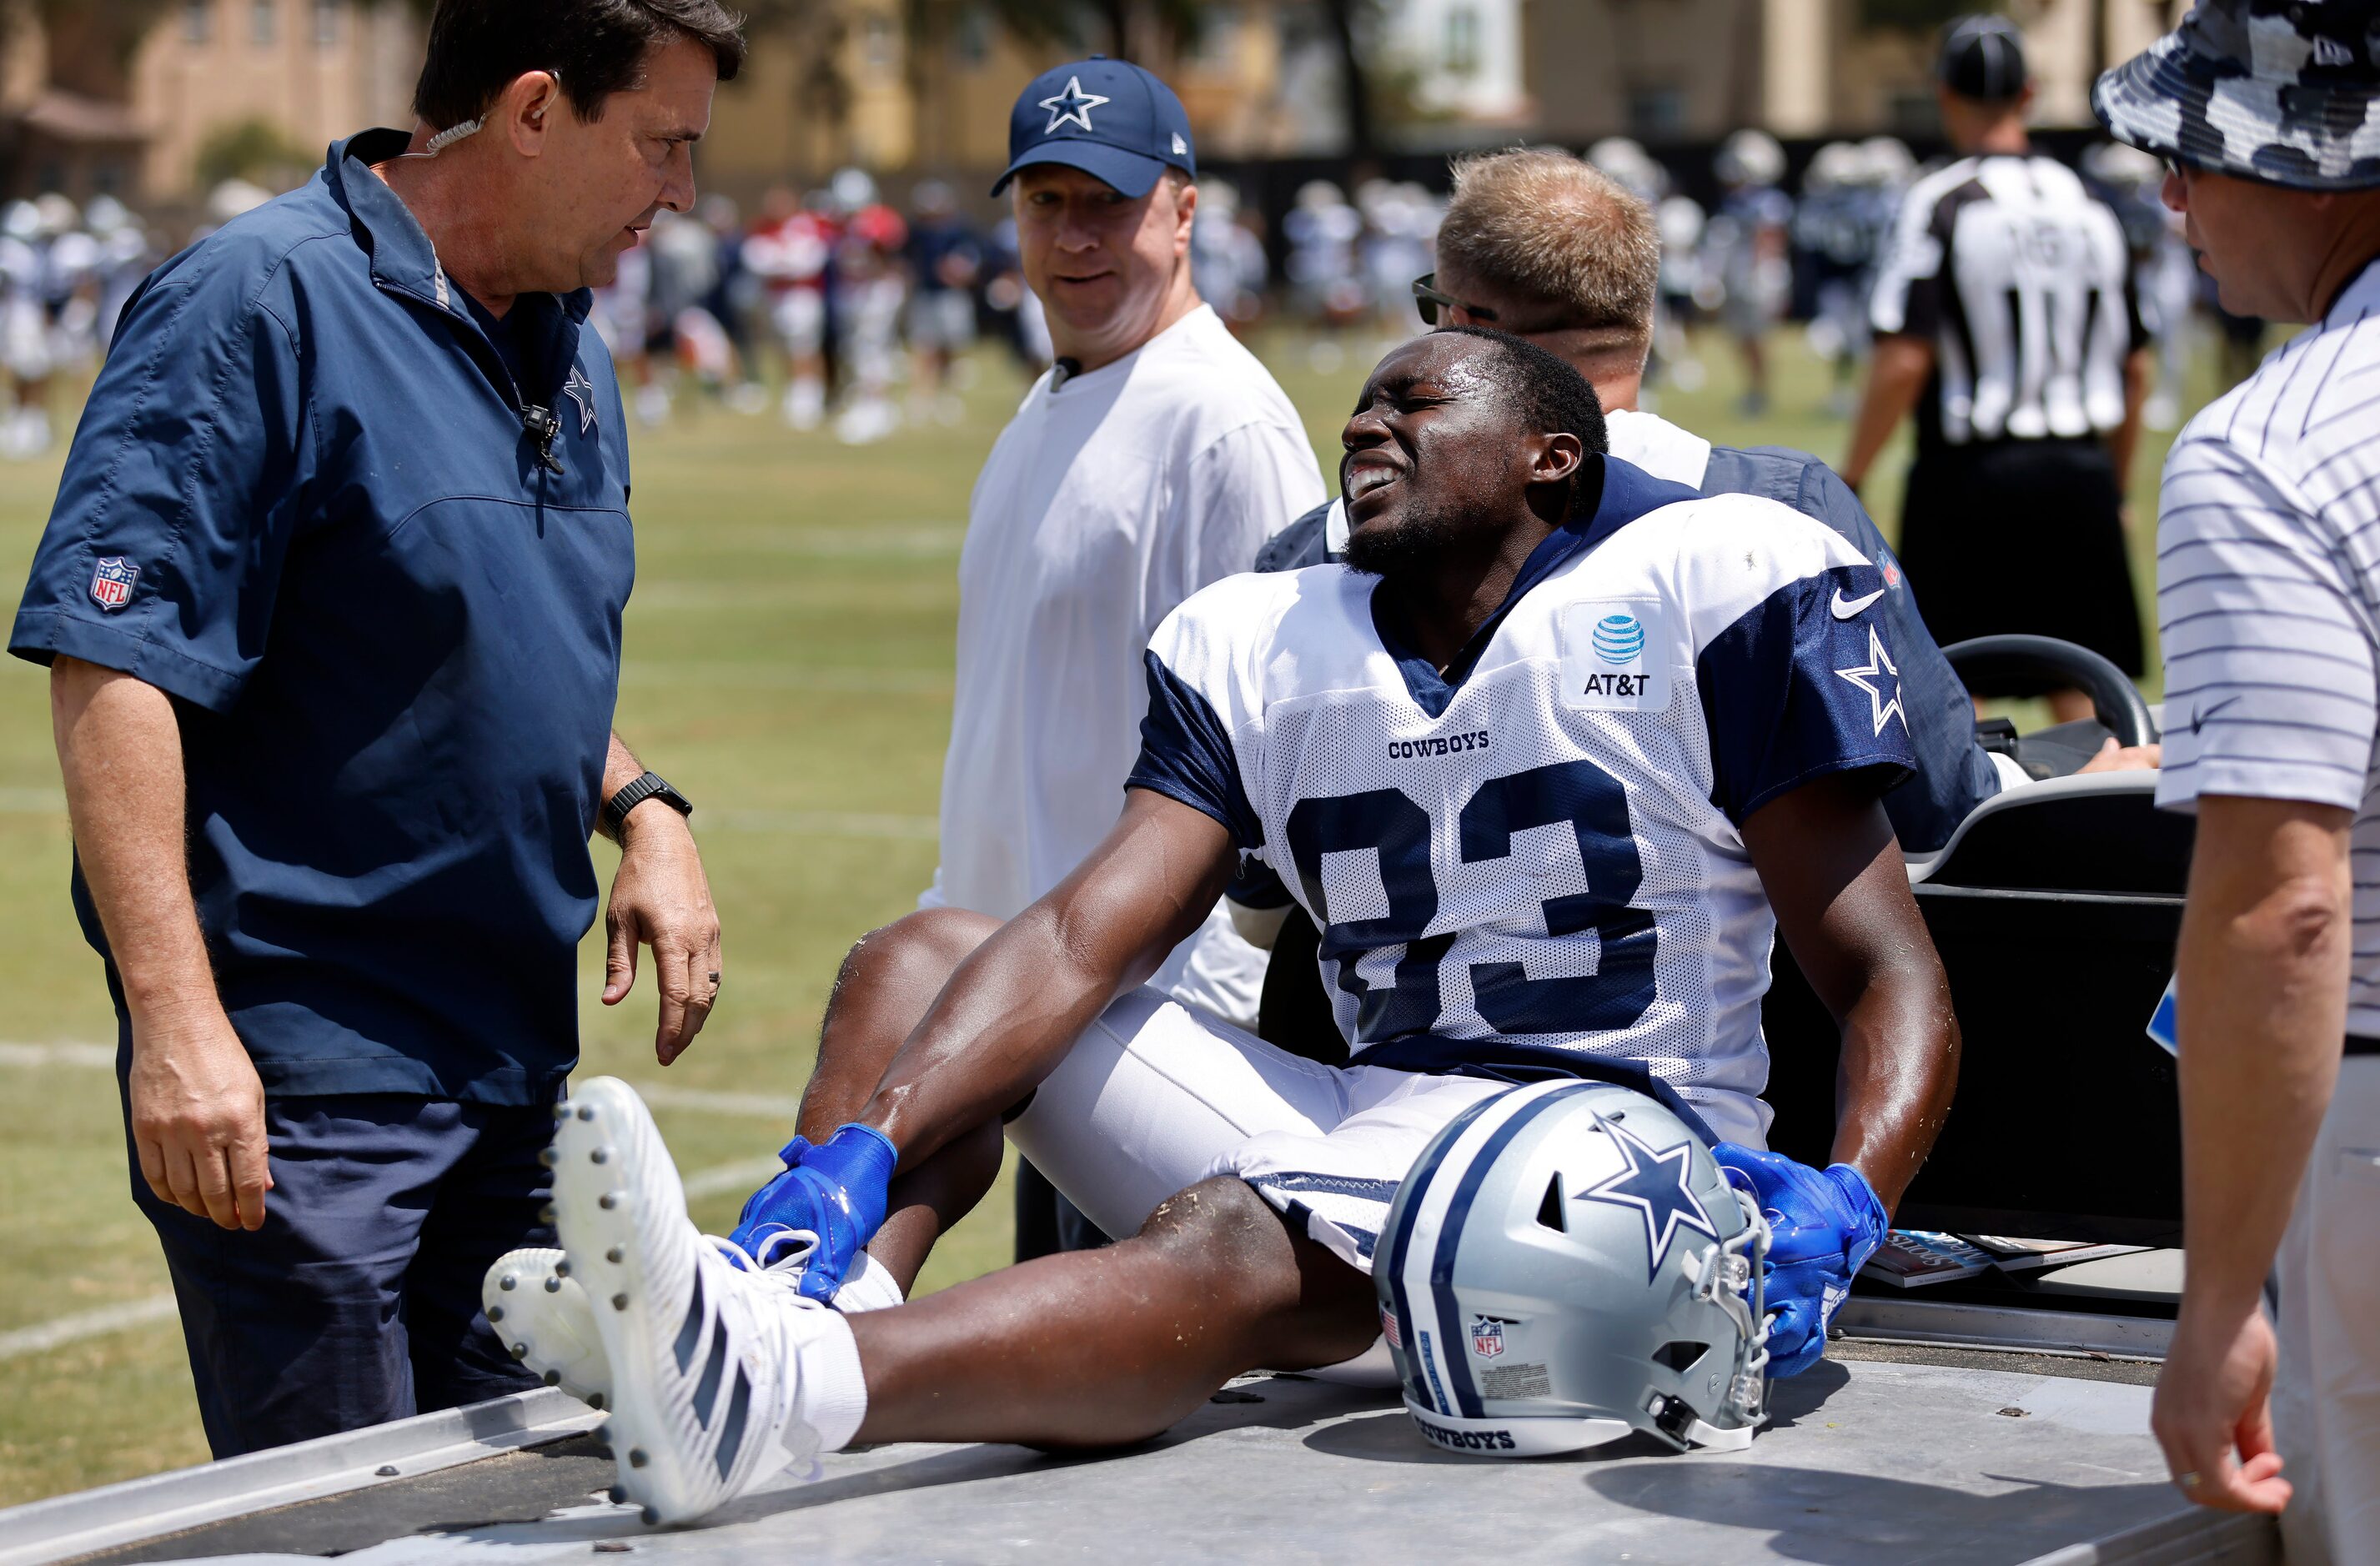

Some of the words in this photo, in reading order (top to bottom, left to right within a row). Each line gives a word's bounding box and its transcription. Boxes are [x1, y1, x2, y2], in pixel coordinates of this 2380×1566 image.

[96, 580, 125, 603] NFL
[1584, 674, 1650, 696] AT&T
[1388, 730, 1489, 760] COWBOYS
[1286, 759, 1658, 1042] 83
[1475, 1337, 1501, 1355] NFL
